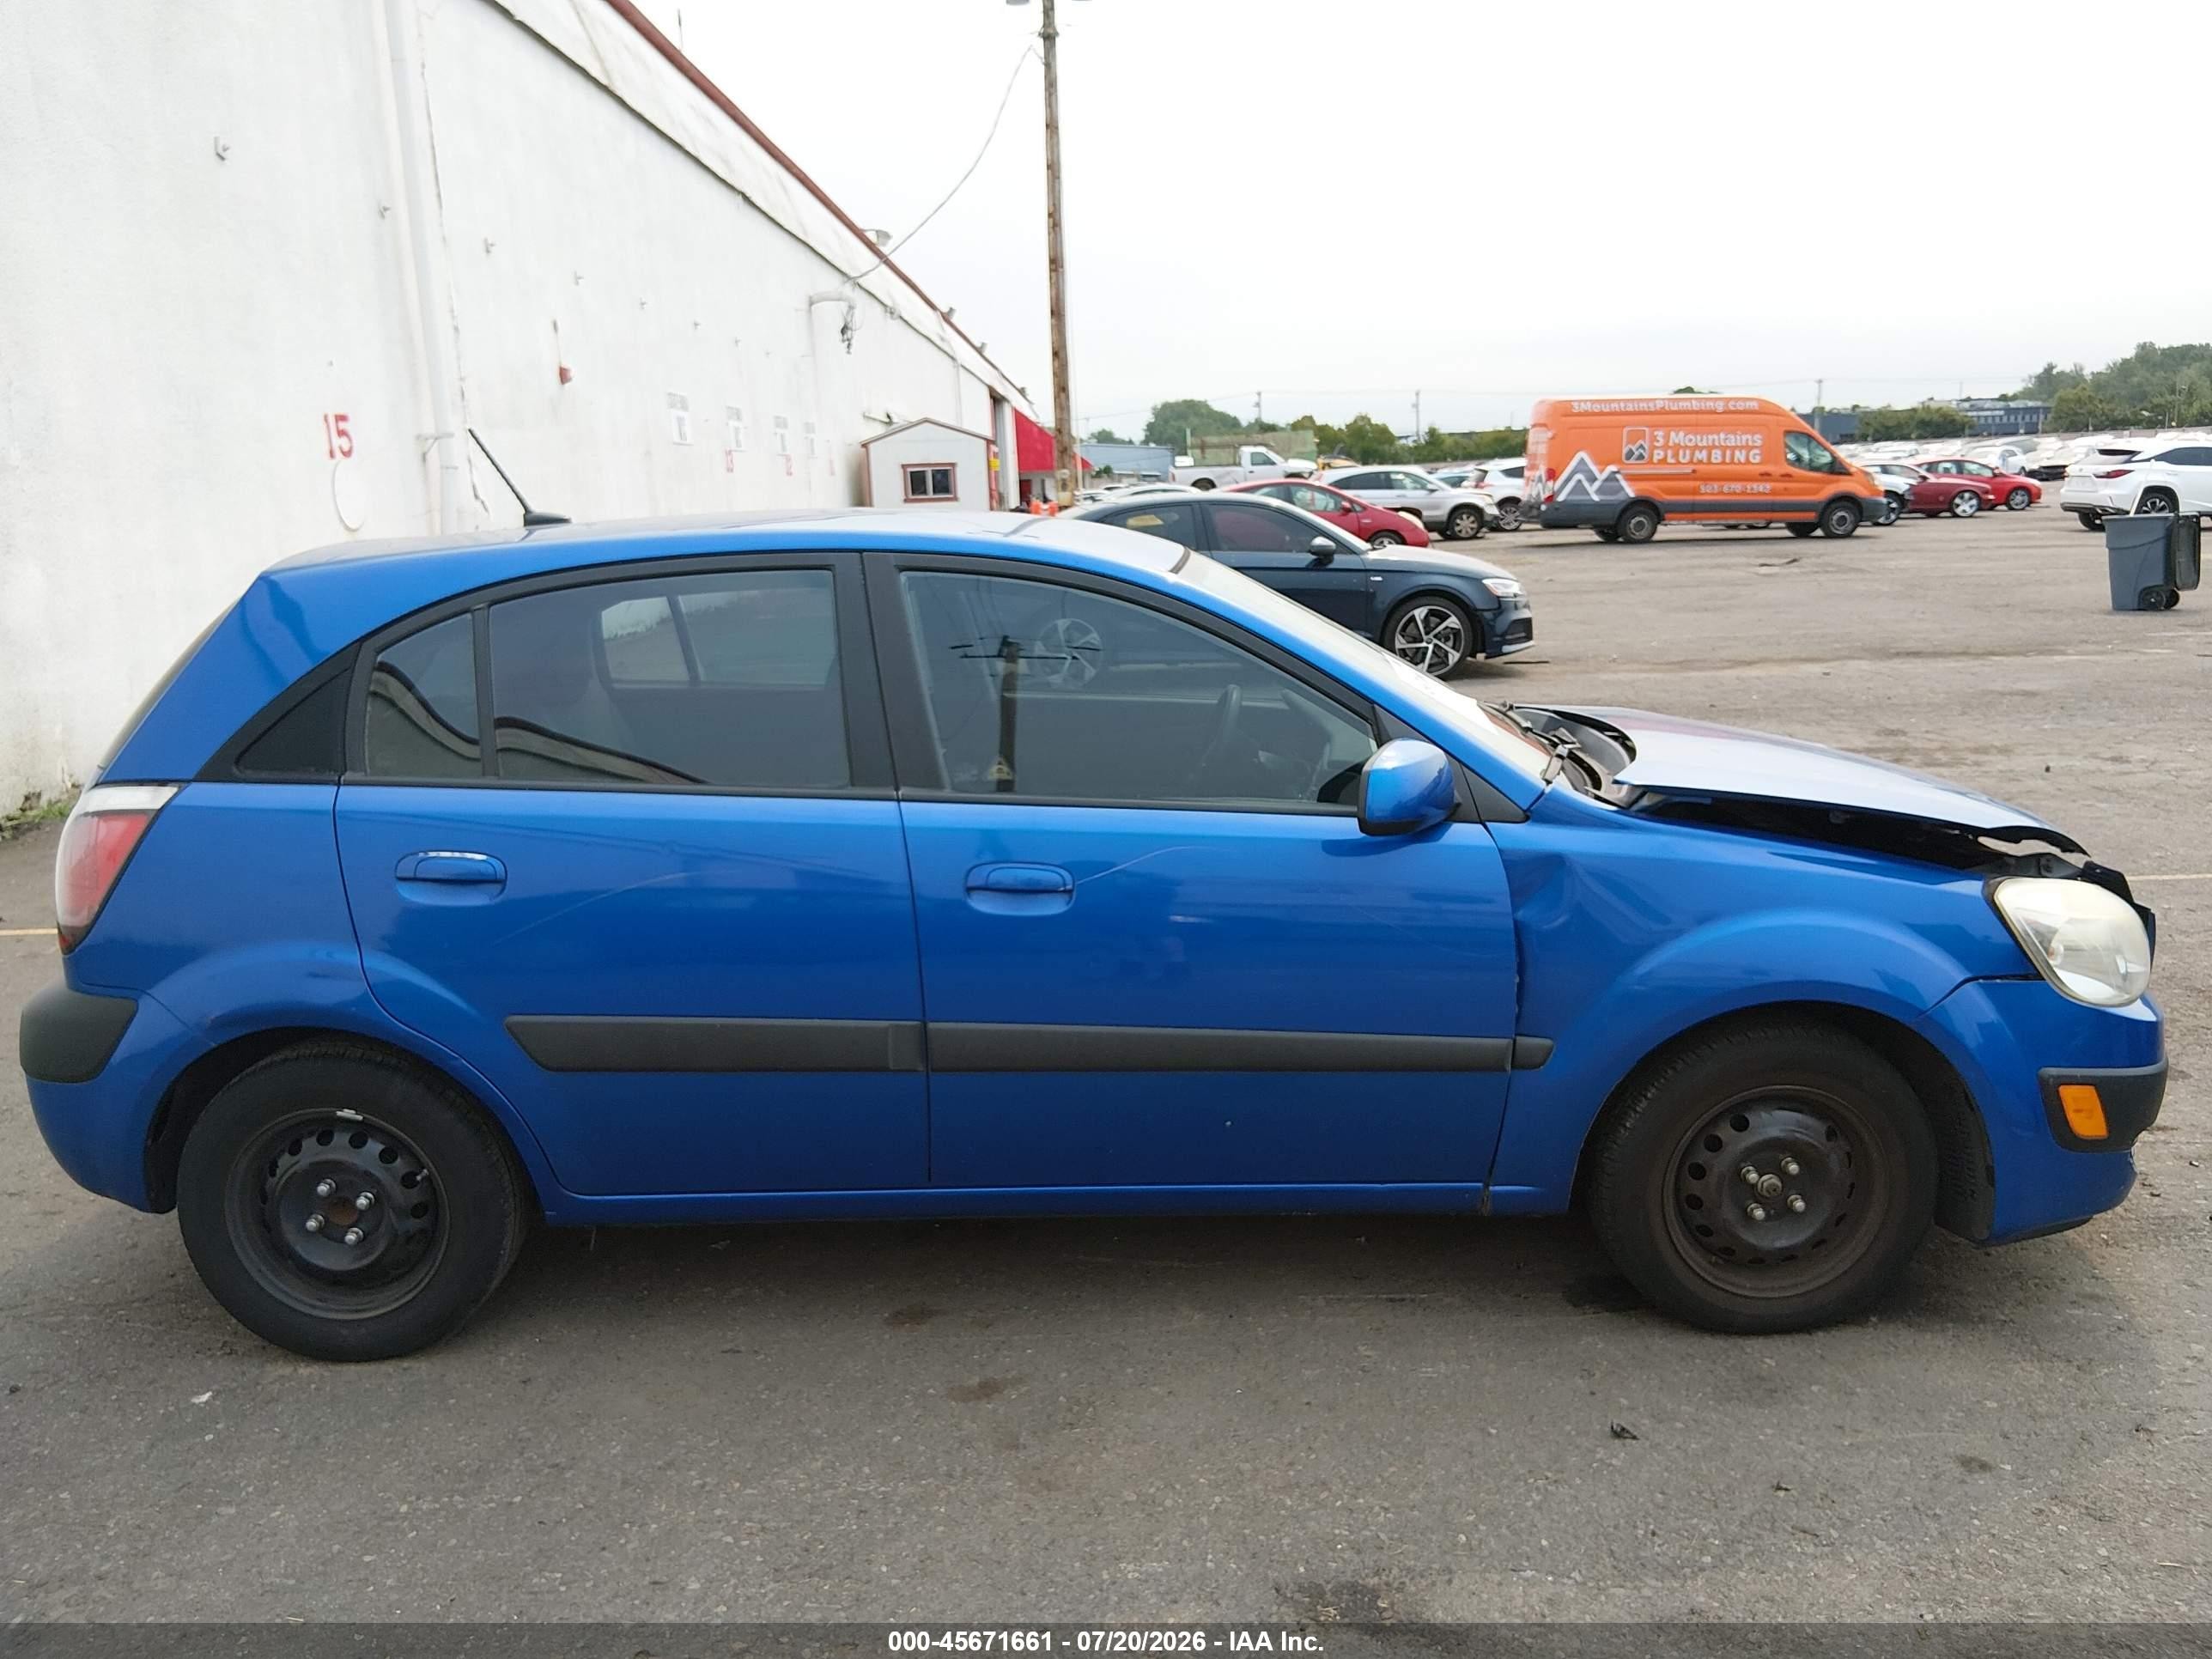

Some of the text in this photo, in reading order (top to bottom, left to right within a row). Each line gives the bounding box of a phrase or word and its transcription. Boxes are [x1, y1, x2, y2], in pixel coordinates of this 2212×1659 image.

[1571, 399, 1759, 412] 3MountainsPlumbingcom
[324, 413, 353, 459] 15
[1653, 431, 1762, 447] 3 Mountains
[1652, 449, 1761, 464] PLUMBING
